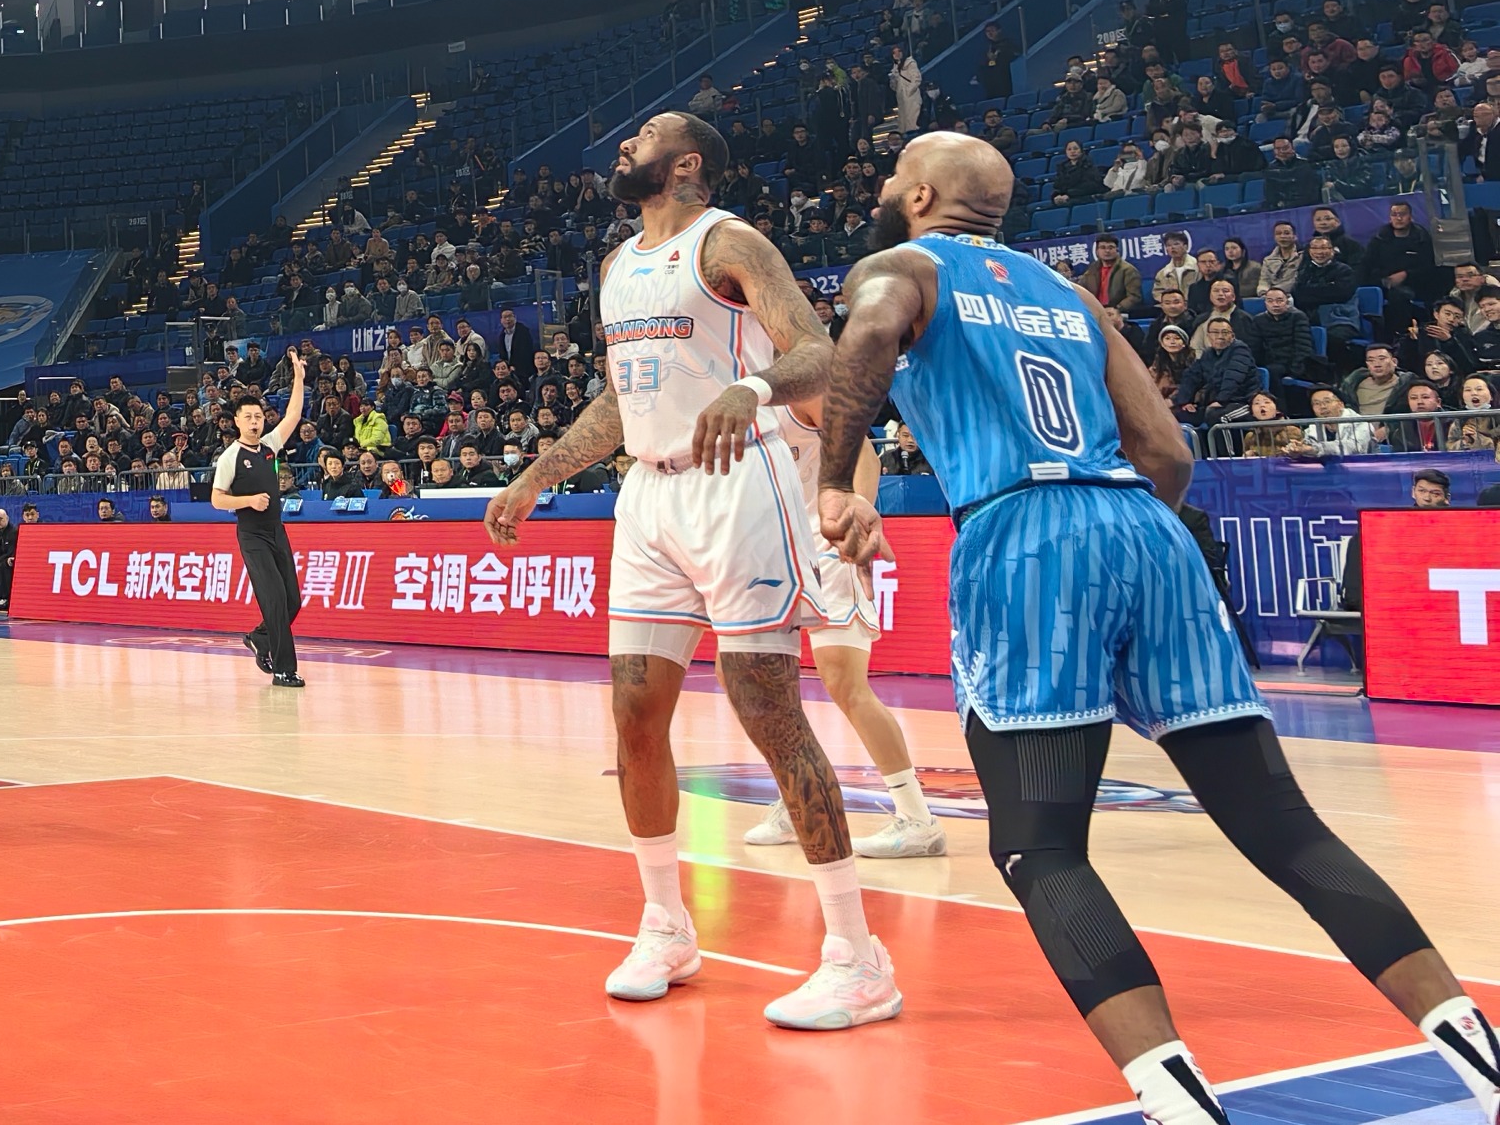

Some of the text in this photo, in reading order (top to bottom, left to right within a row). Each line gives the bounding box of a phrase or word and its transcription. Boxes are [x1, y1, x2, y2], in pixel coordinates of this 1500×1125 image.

[604, 316, 693, 346] HANDONG
[952, 290, 1091, 344] 四川金强
[616, 356, 662, 396] 33
[1014, 349, 1085, 457] 0
[48, 548, 119, 597] TCL
[123, 550, 234, 604] 新风空调
[391, 552, 597, 618] 空调会呼吸
